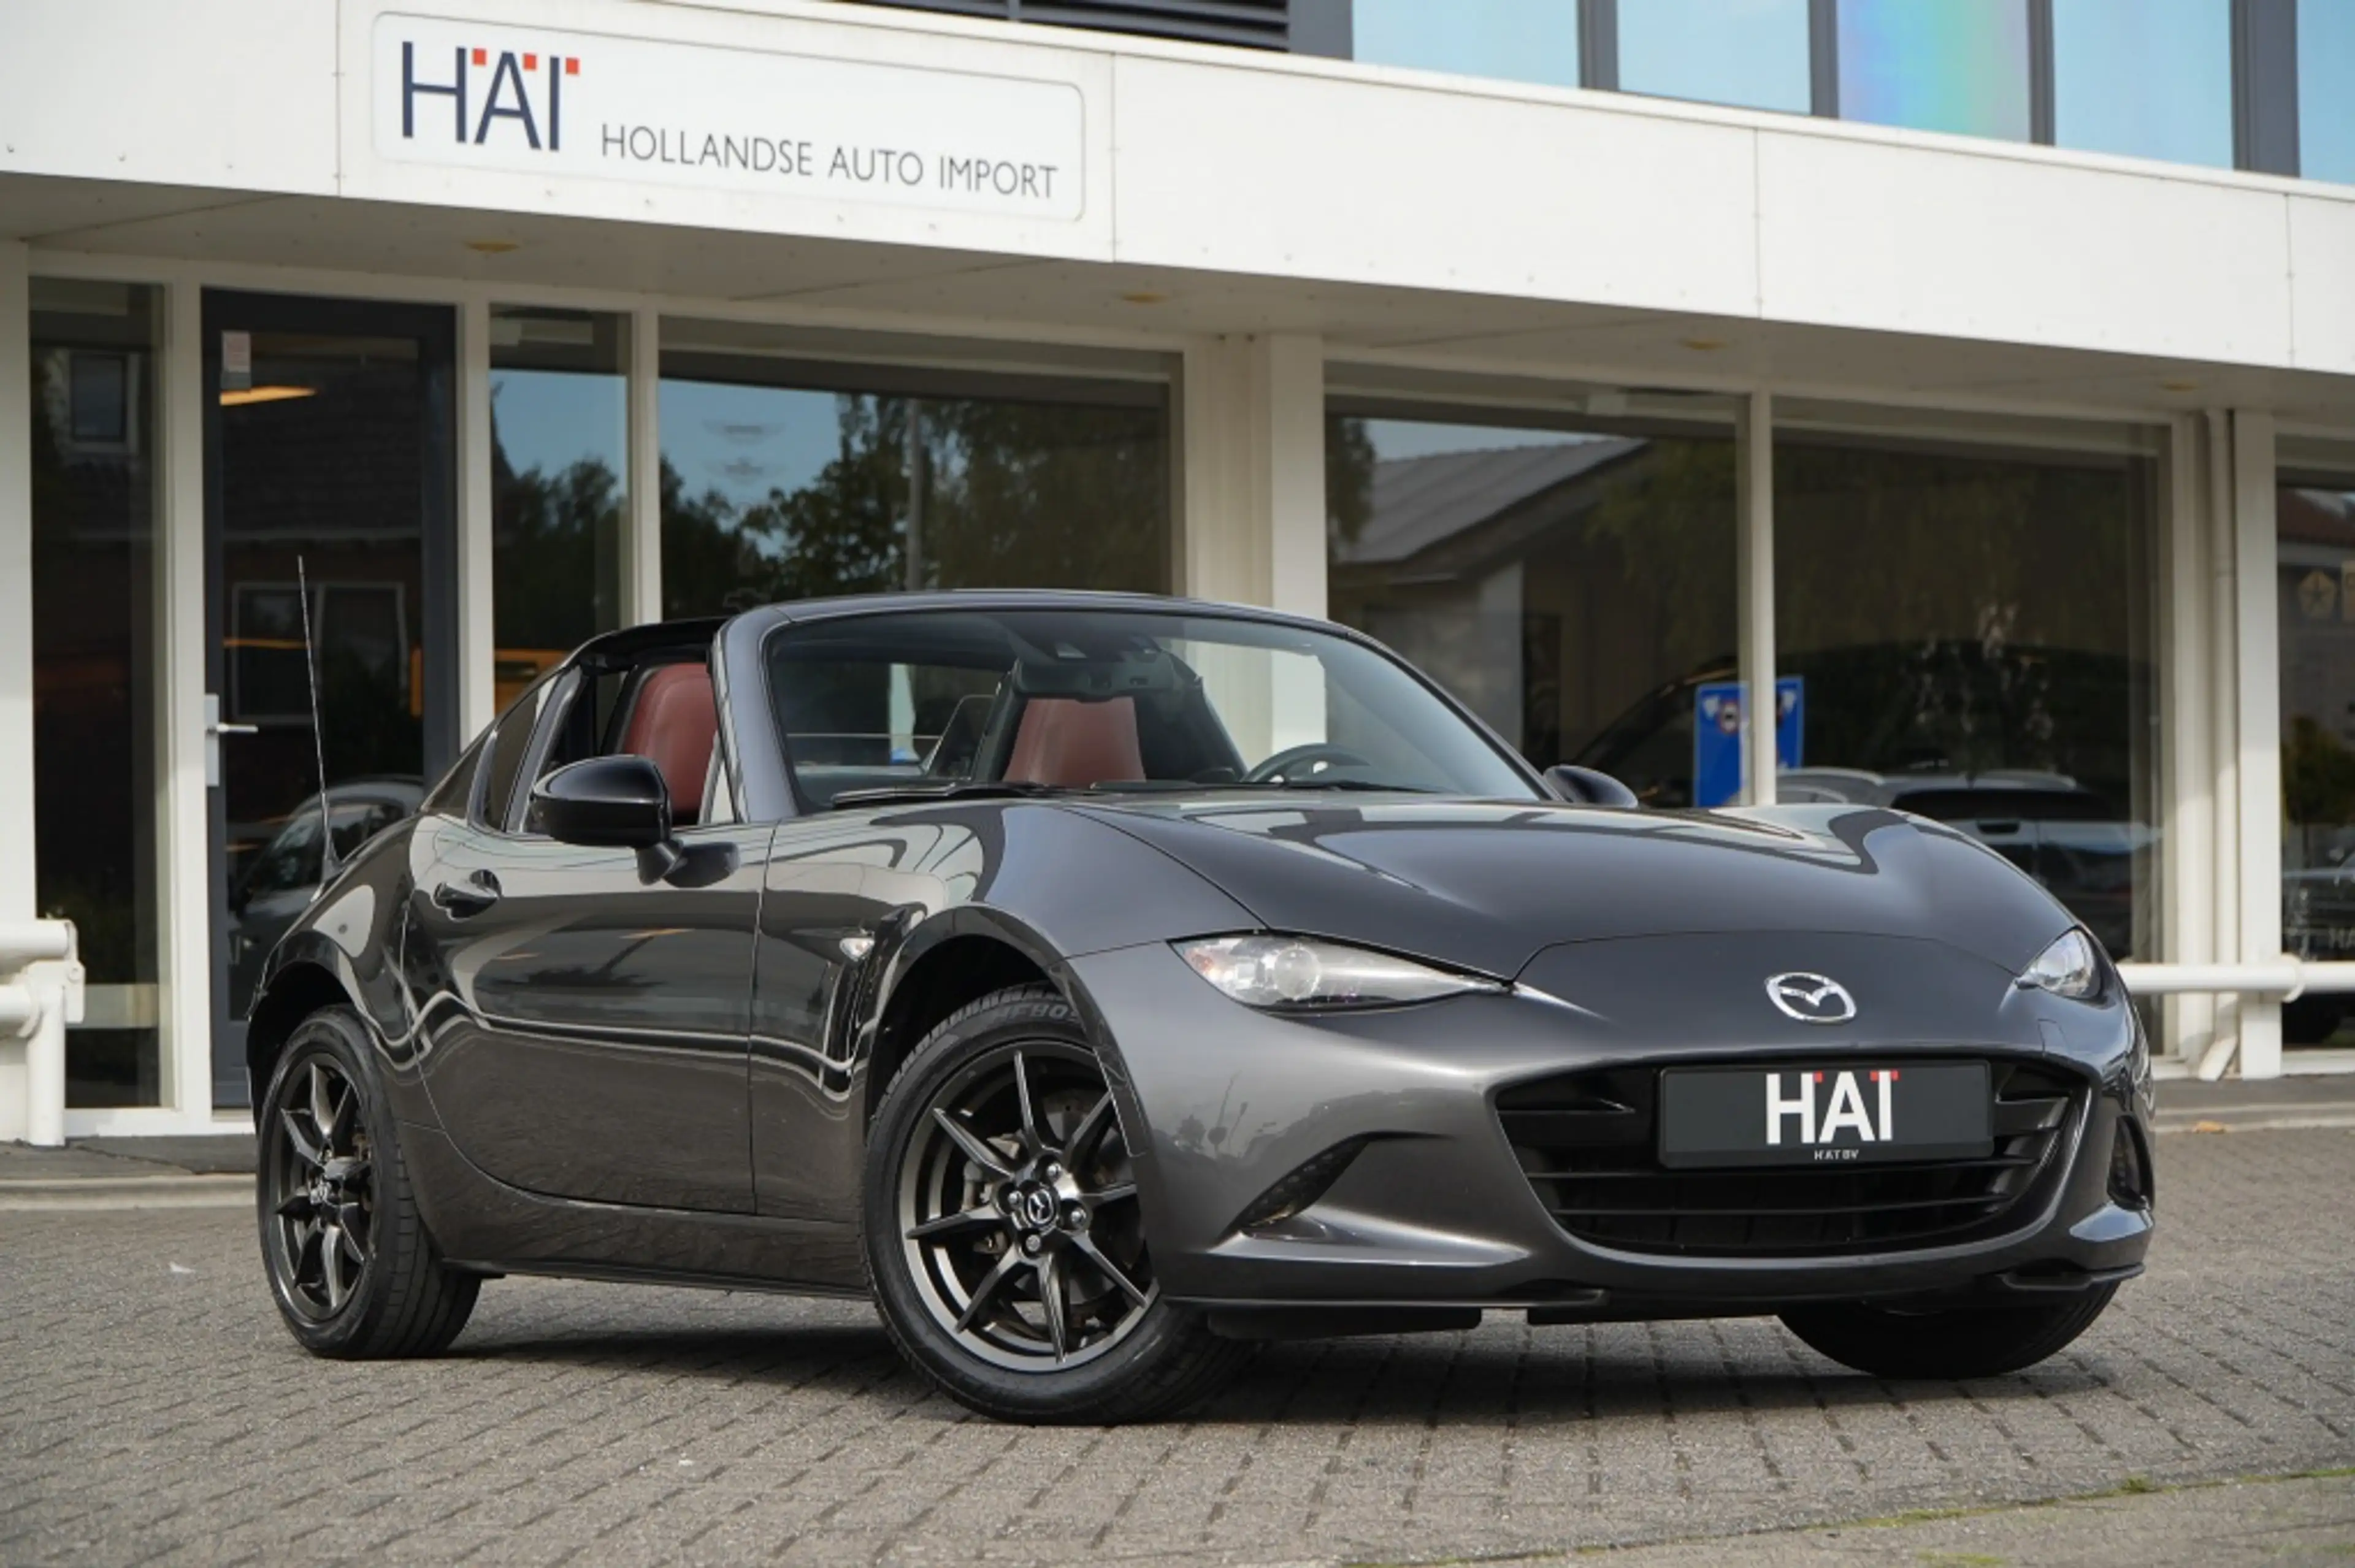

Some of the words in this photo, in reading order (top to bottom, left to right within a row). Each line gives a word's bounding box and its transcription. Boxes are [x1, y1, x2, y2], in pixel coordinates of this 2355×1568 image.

[602, 123, 813, 178] HOLLANDSE
[828, 147, 924, 188] AUTO
[940, 156, 1059, 199] IMPORT
